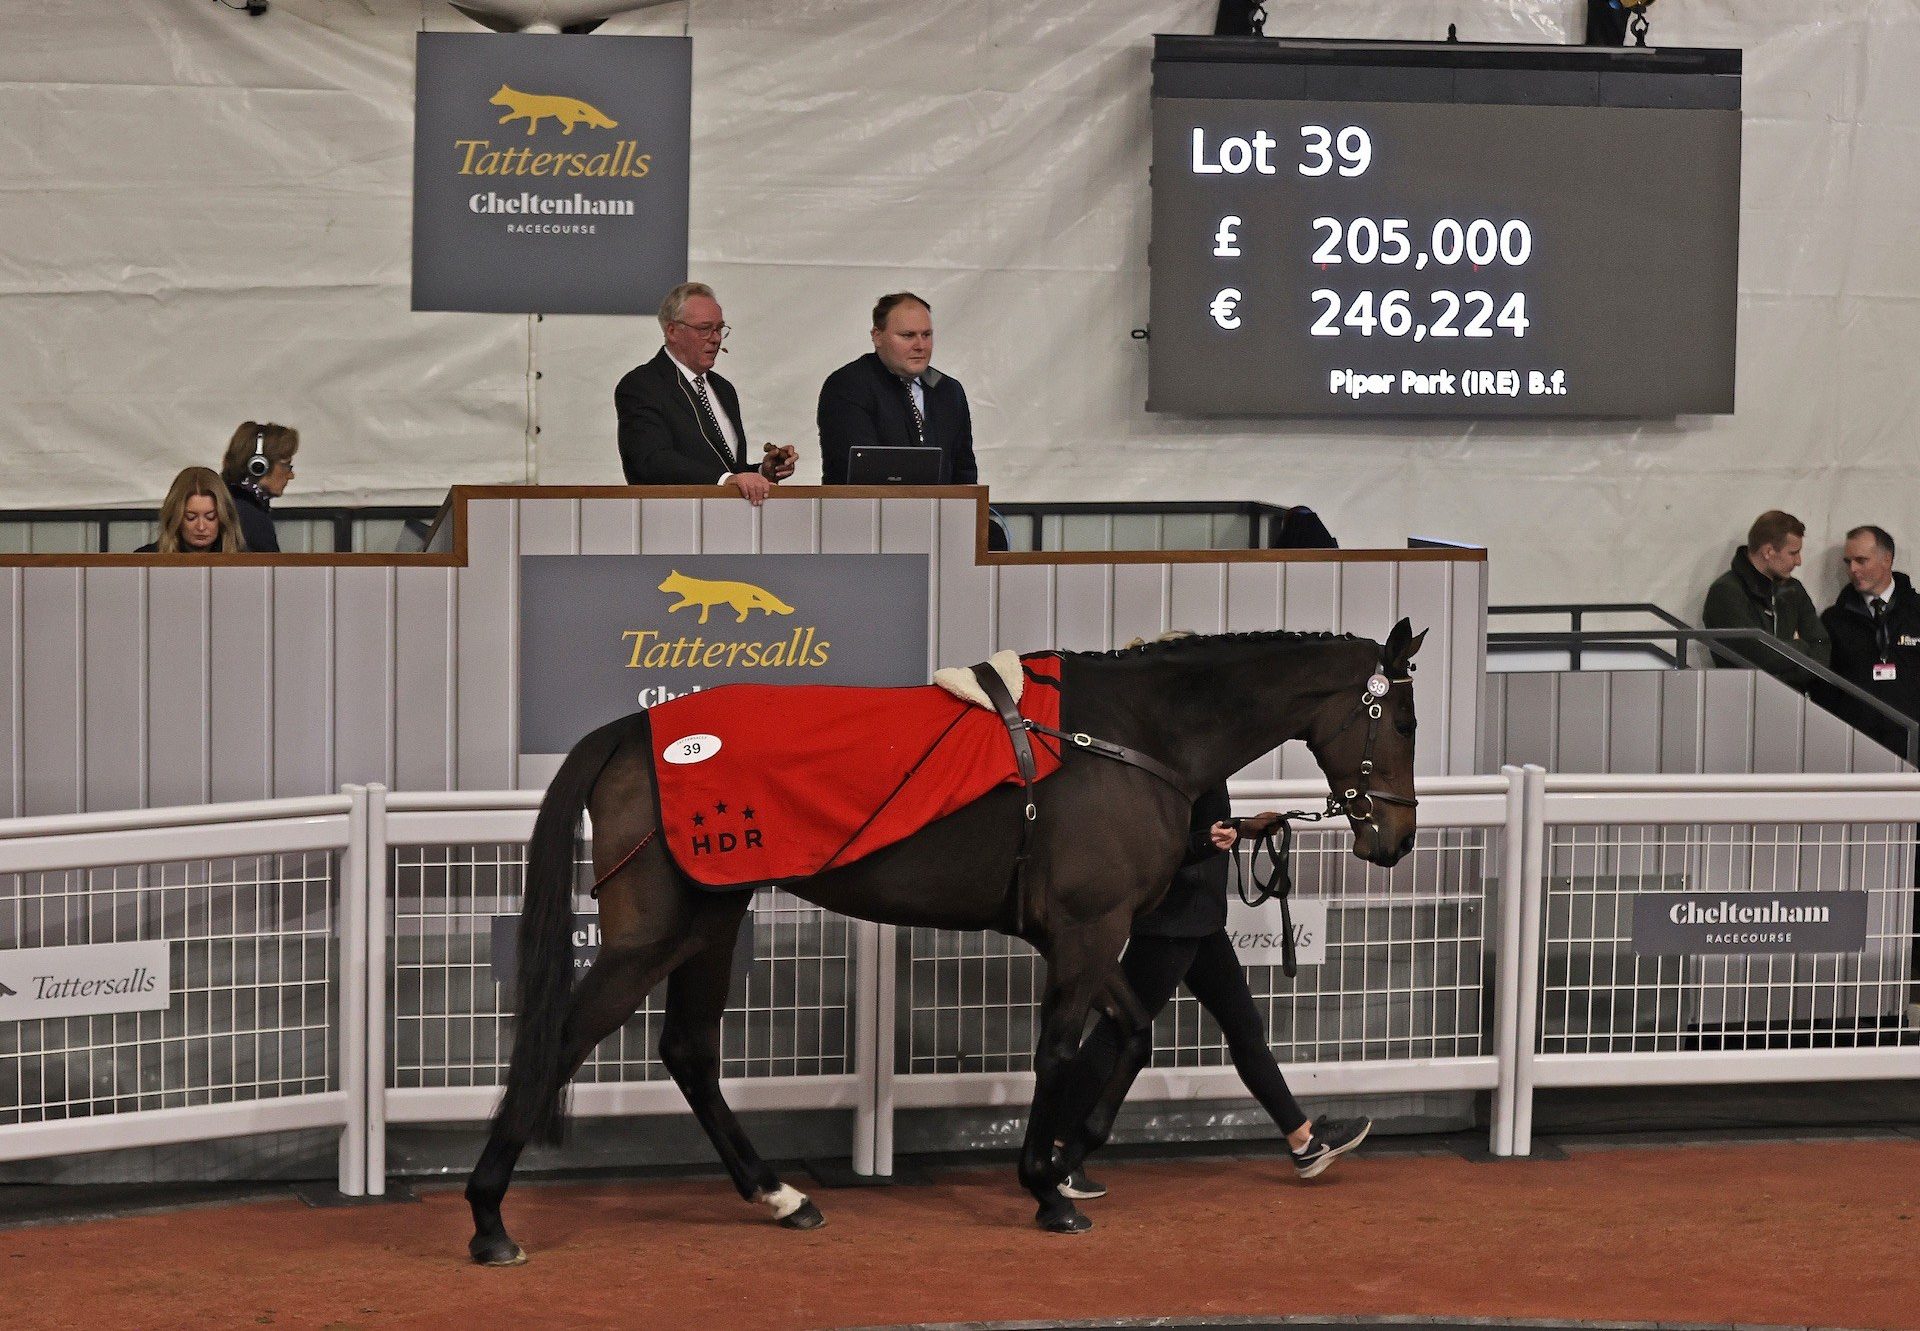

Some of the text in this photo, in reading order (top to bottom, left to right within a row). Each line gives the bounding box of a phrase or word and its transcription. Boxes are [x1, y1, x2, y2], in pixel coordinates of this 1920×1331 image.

[454, 139, 652, 178] Tattersalls
[1192, 125, 1372, 177] Lot 39
[468, 192, 634, 215] Cheltenham
[507, 224, 596, 234] RACECOURSE
[1213, 215, 1532, 270] £ 205,000
[1210, 288, 1530, 342] € 246,224
[1330, 369, 1567, 399] Piper Park (IRE) B.f.
[621, 627, 831, 669] Tattersalls
[1369, 680, 1386, 694] 39
[683, 743, 701, 756] 39
[692, 829, 763, 856] HDR
[1669, 900, 1829, 924] Cheltenham
[1706, 933, 1793, 944] RACECOURSE
[32, 967, 156, 1000] Tattersalls
